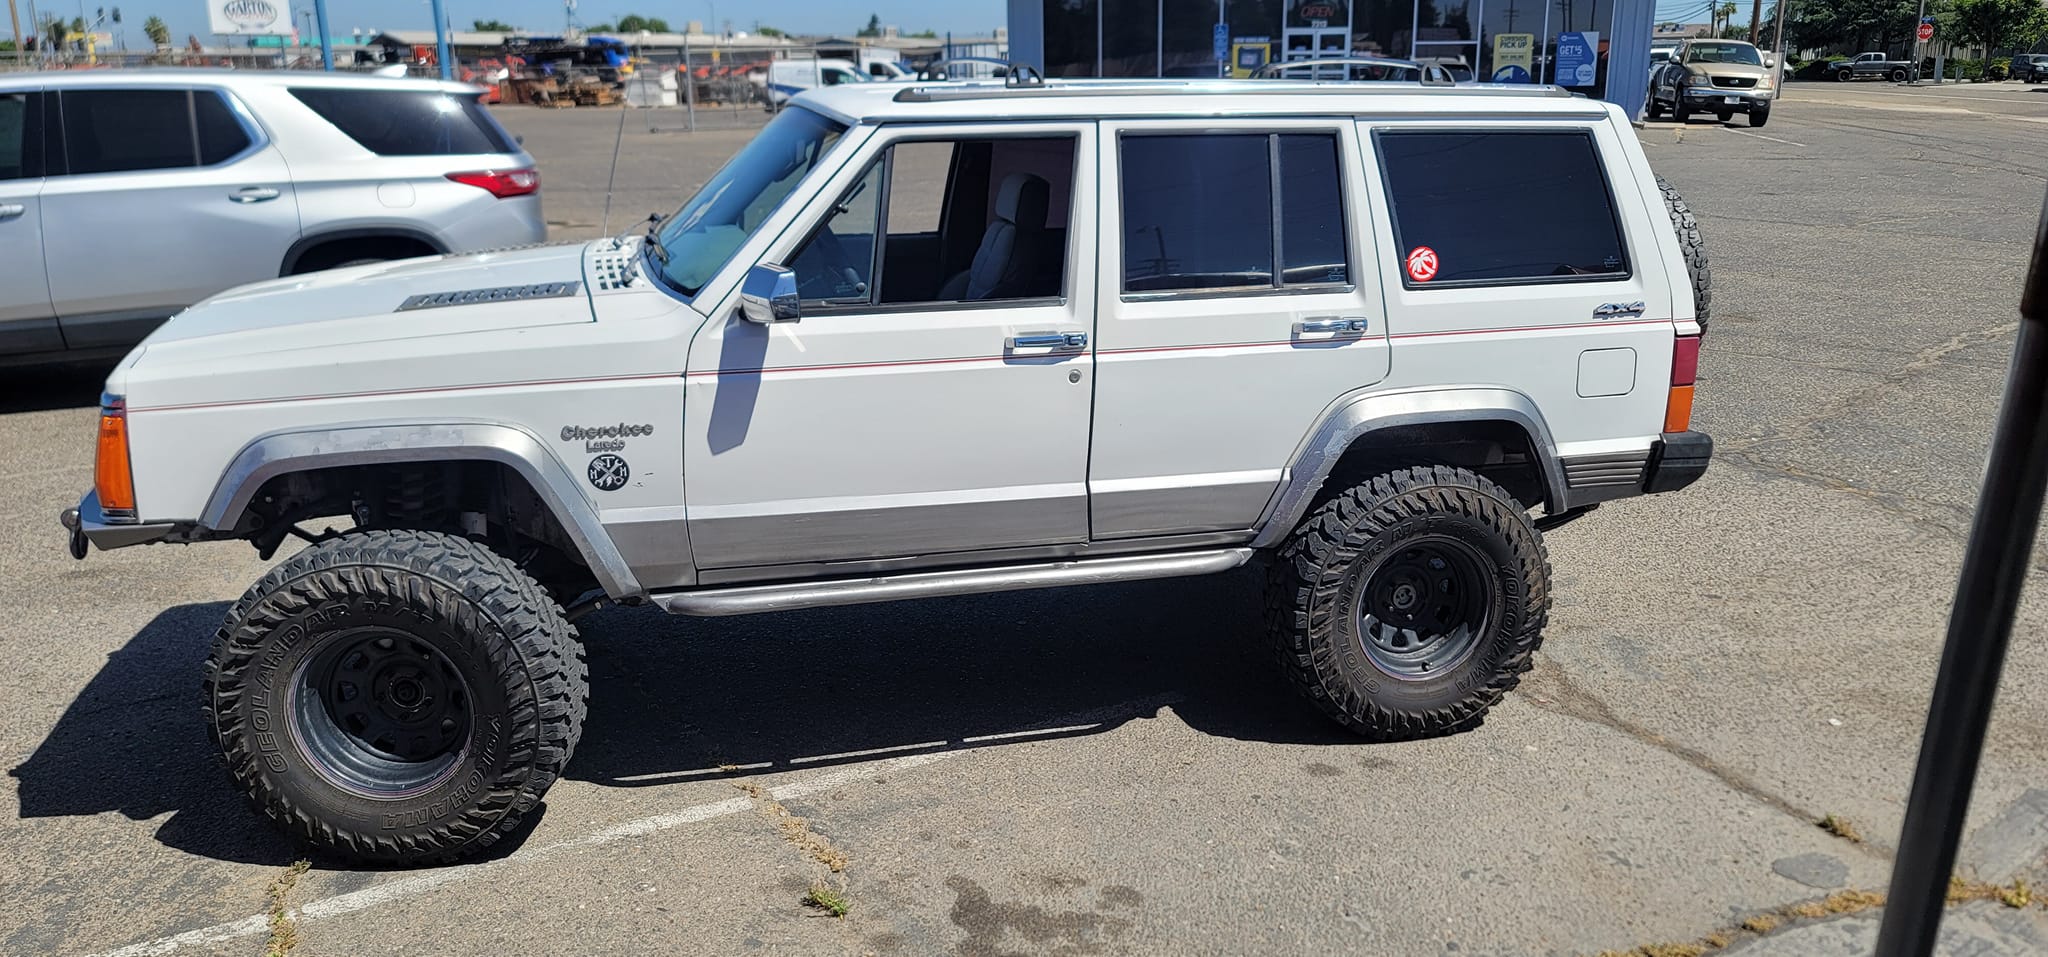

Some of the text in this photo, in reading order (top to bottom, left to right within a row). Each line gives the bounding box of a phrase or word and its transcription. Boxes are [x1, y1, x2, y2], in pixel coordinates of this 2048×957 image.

[227, 0, 272, 15] GARTON
[1301, 6, 1334, 17] OPEN
[1918, 28, 1934, 36] STOP
[1501, 41, 1517, 49] PICK
[1560, 45, 1573, 55] GET
[560, 422, 653, 441] Cherokee
[586, 438, 625, 453] Laredo
[1337, 538, 1386, 694] GEOLANDAR
[1456, 561, 1520, 694] YOKOHAMA
[250, 602, 352, 774] GEOLANDAR
[380, 711, 503, 830] YOKOHAMA
